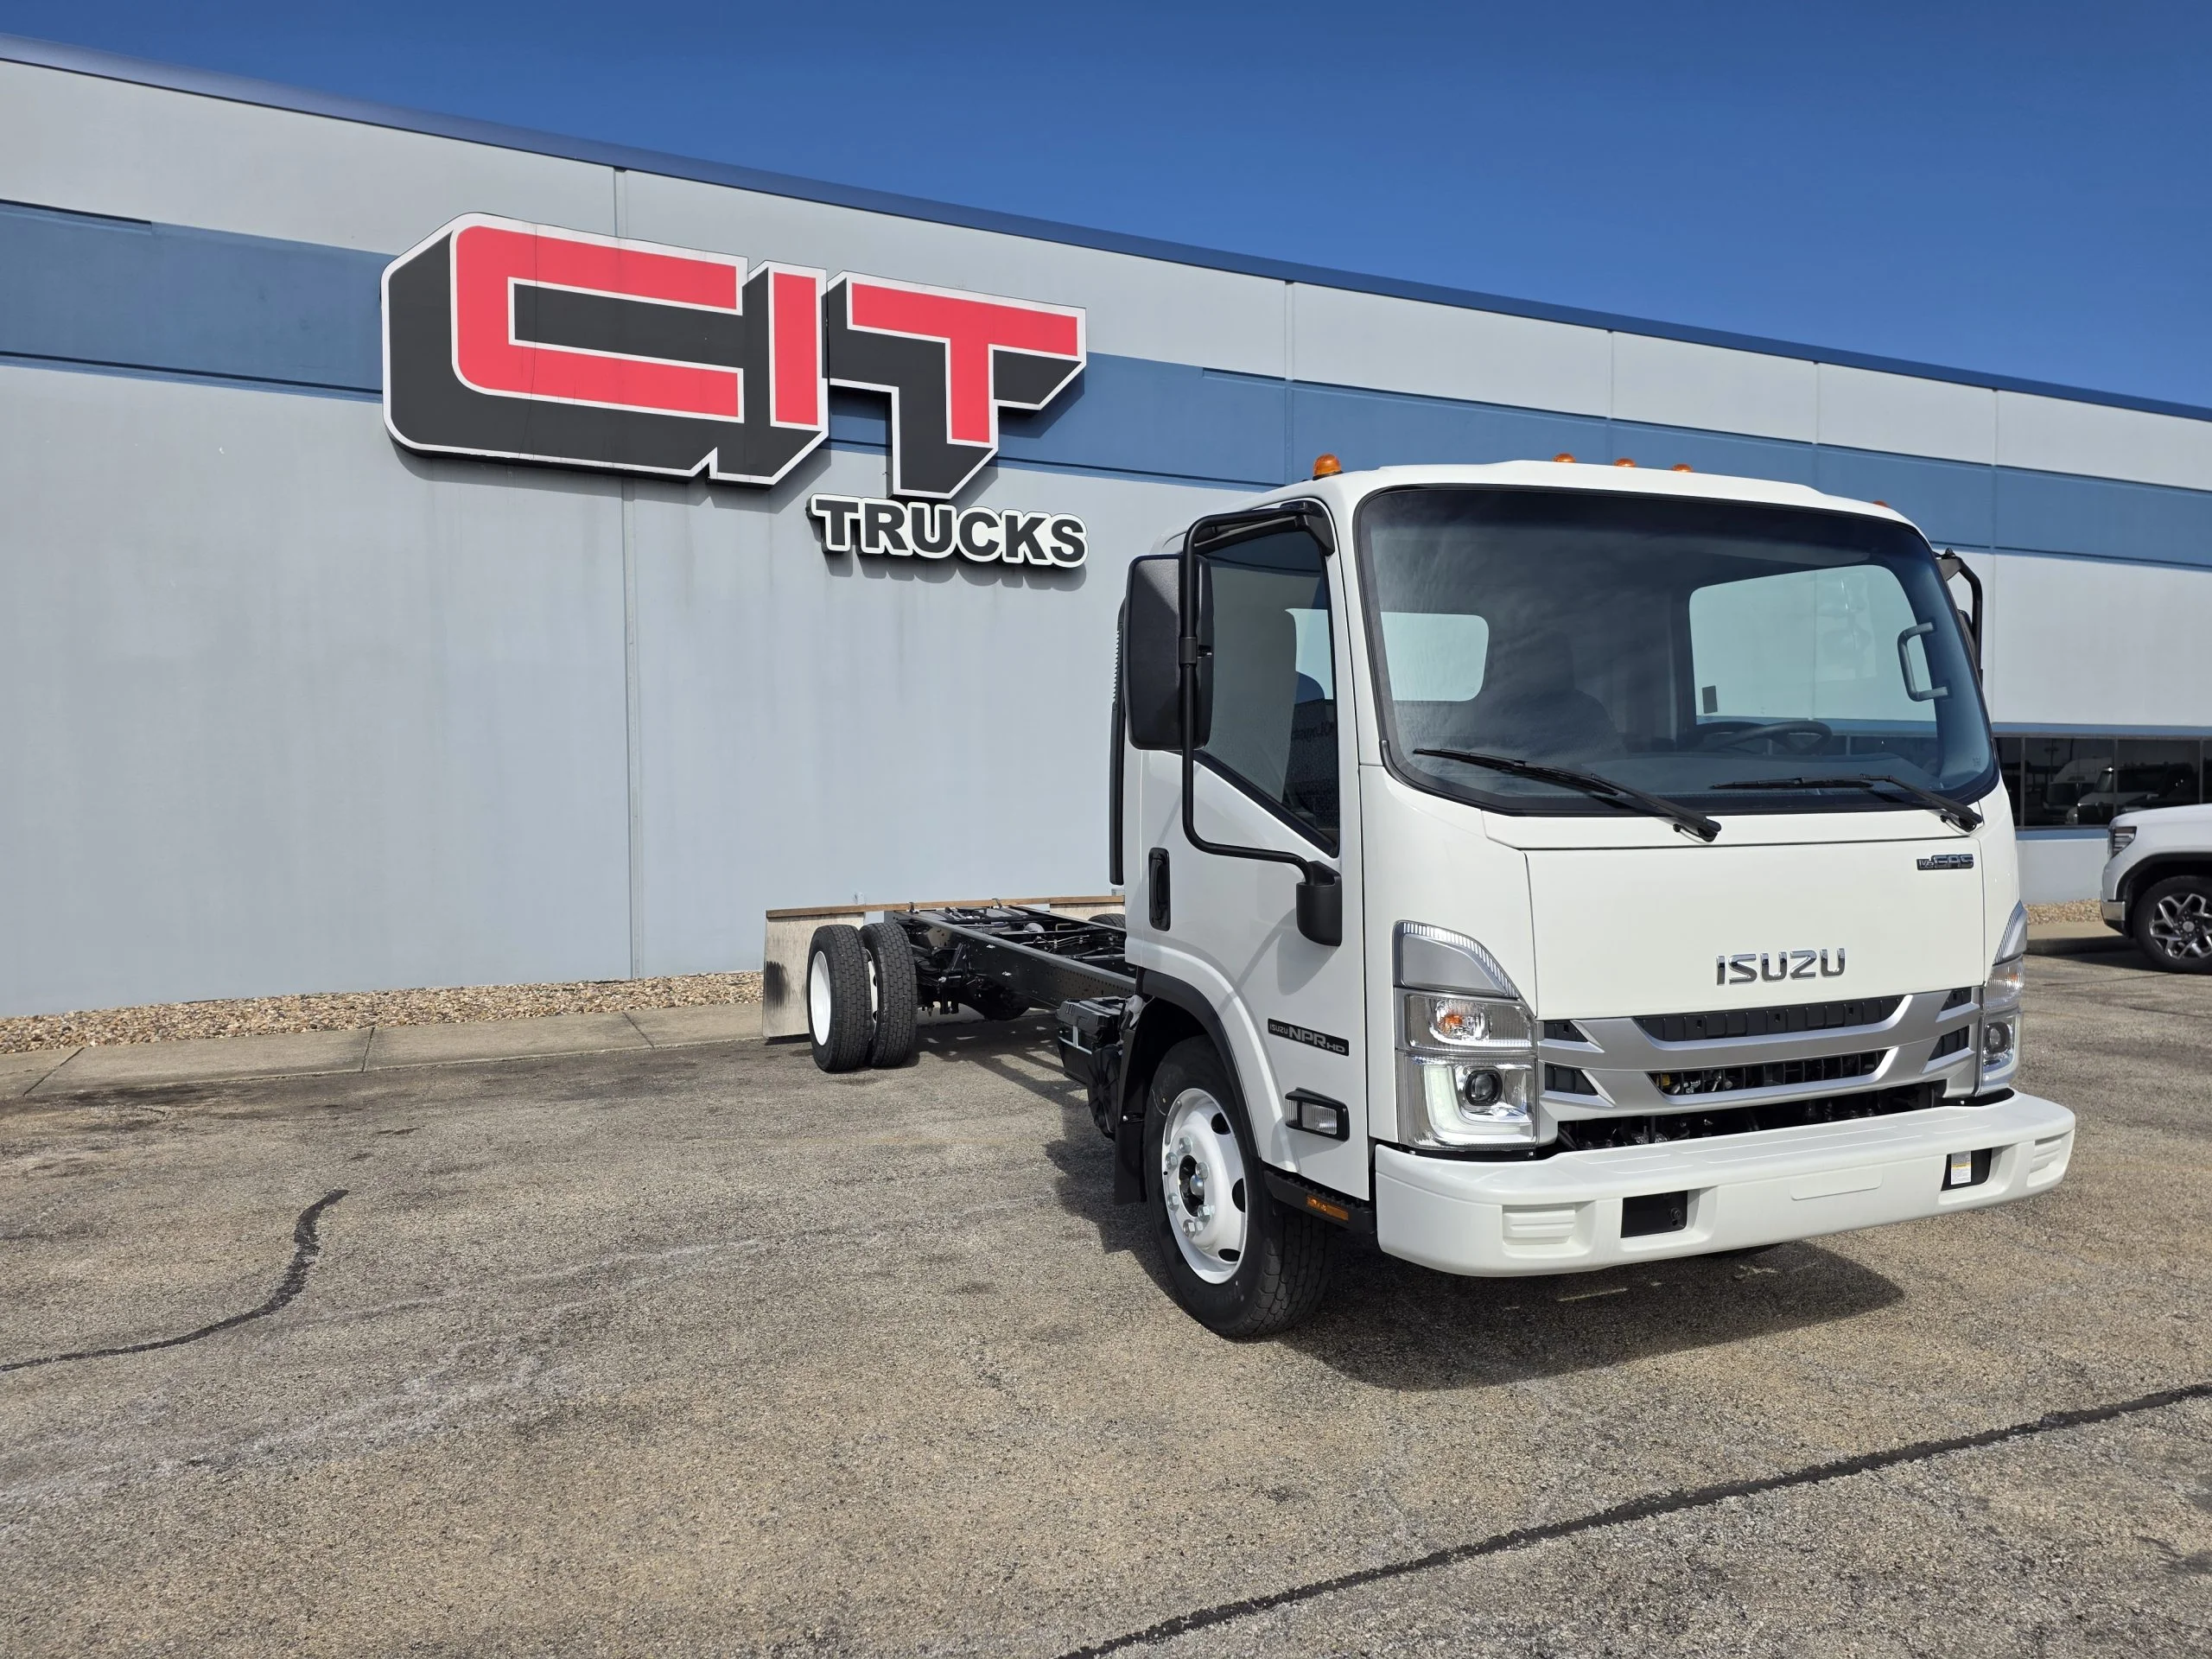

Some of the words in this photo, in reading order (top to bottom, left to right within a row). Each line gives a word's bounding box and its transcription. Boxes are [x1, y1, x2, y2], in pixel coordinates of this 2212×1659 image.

[383, 213, 1087, 499] CIT
[810, 494, 1087, 568] TRUCKS
[1716, 948, 1846, 986] ISUZU
[1269, 1023, 1288, 1034] ISUZU
[1288, 1026, 1326, 1048] NPR
[1326, 1042, 1345, 1053] HD
